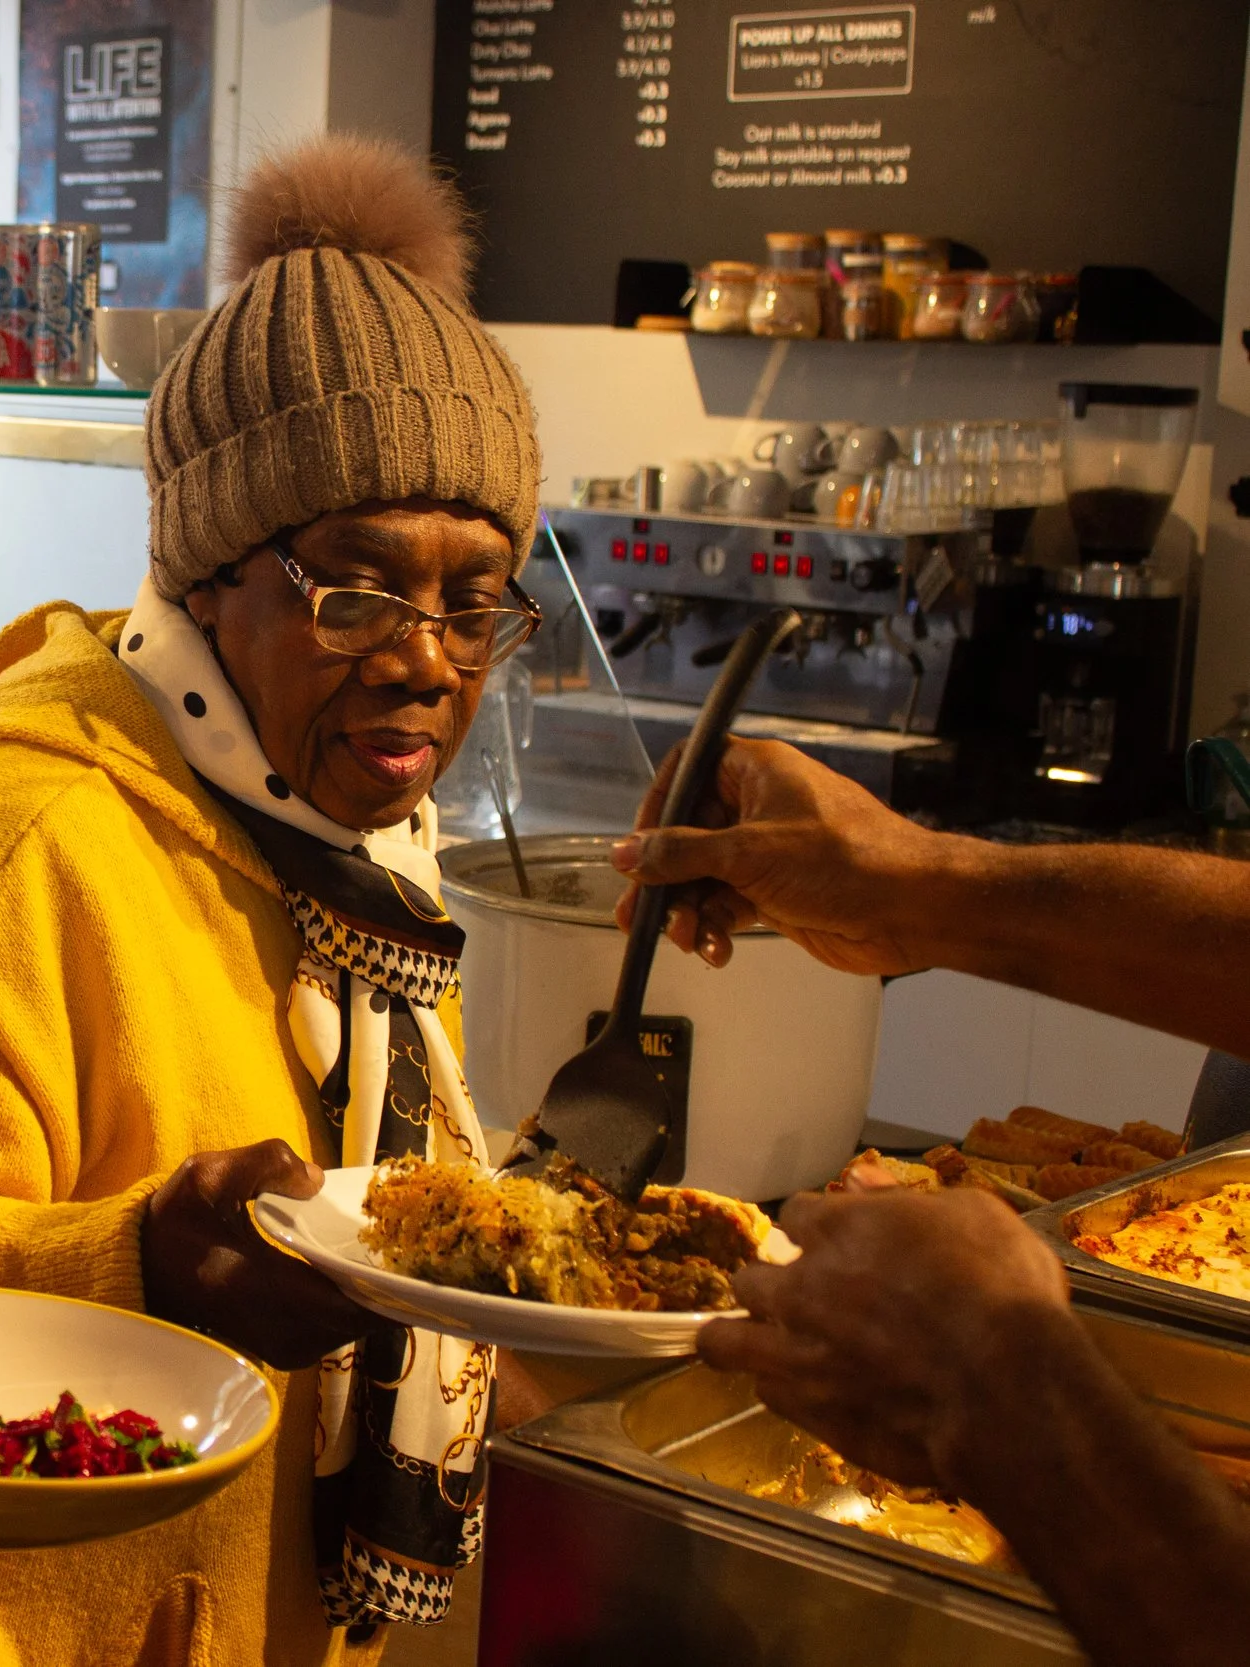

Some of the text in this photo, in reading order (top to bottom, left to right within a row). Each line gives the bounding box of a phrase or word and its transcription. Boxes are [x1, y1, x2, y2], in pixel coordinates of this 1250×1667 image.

[739, 20, 902, 47] POWER UP ALL DRINKS
[63, 37, 163, 101] LIFE
[774, 121, 801, 142] milk
[817, 118, 882, 141] standard
[741, 145, 769, 165] milk
[770, 144, 834, 165] available
[856, 144, 911, 167] request
[789, 166, 843, 187] Almond
[843, 165, 872, 186] milk
